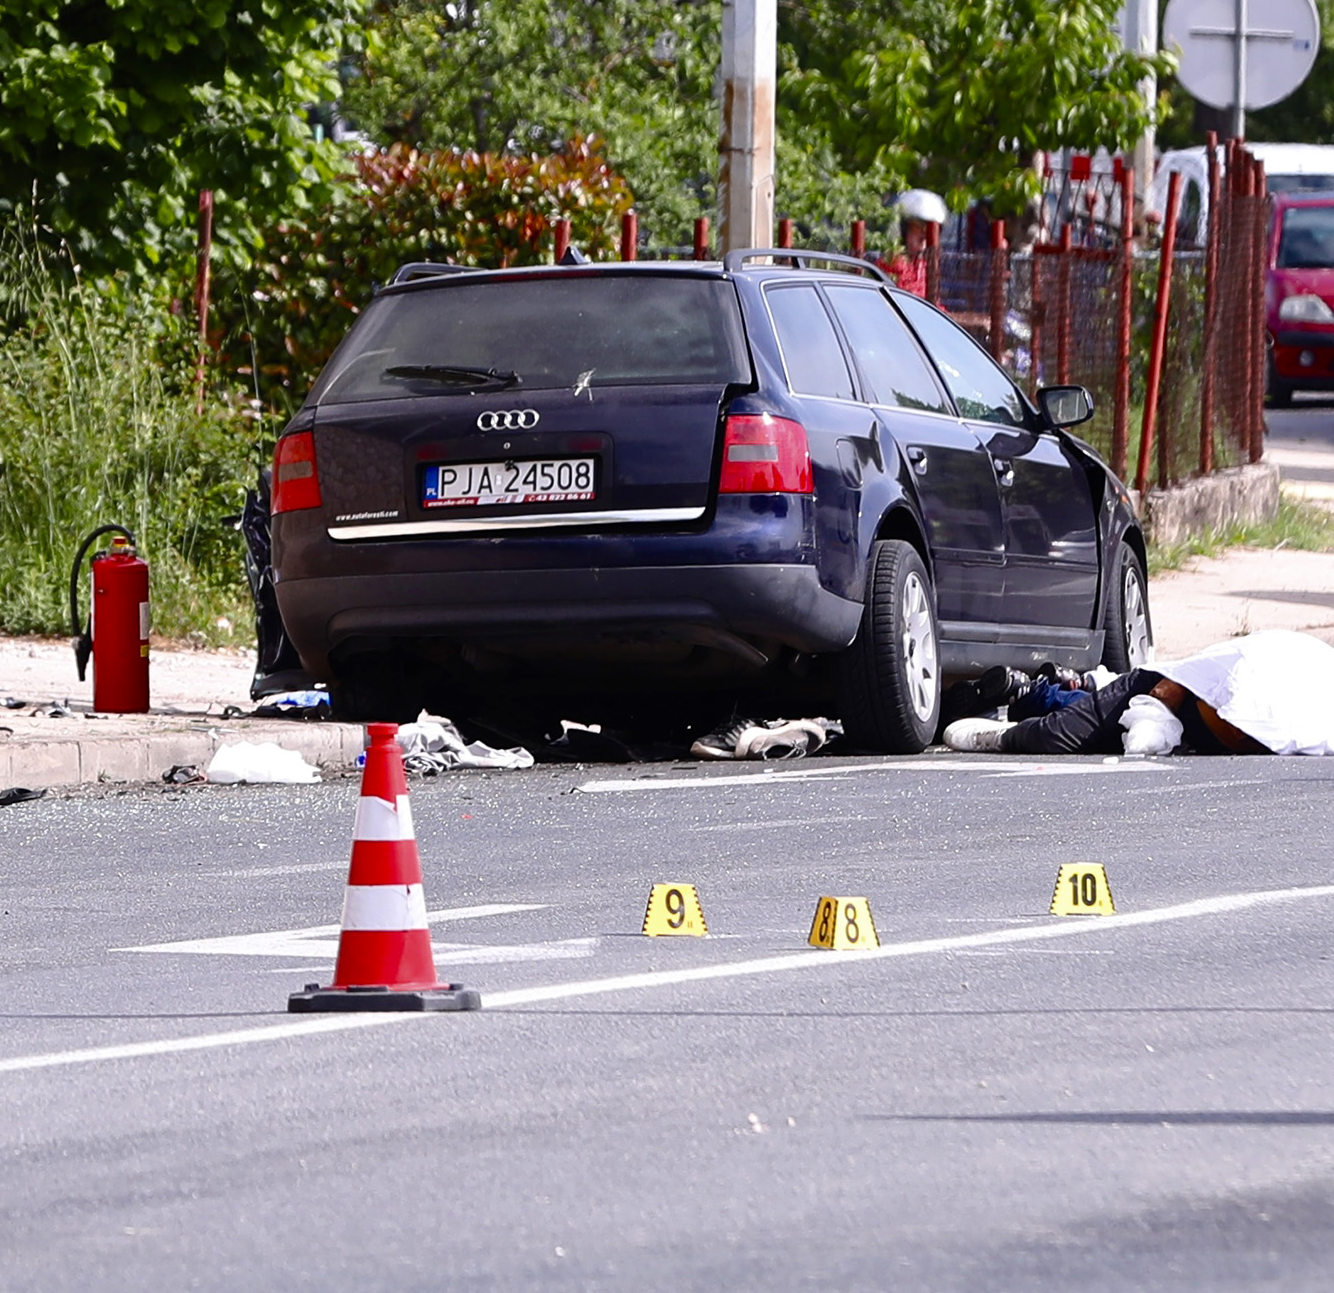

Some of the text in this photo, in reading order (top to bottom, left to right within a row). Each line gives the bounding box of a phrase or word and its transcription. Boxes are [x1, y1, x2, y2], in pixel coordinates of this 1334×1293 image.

[426, 487, 437, 496] PL
[441, 461, 591, 497] PJA 24508
[665, 888, 685, 929] 9
[1069, 873, 1097, 906] 10
[819, 901, 831, 942] 8
[844, 903, 859, 943] 8
